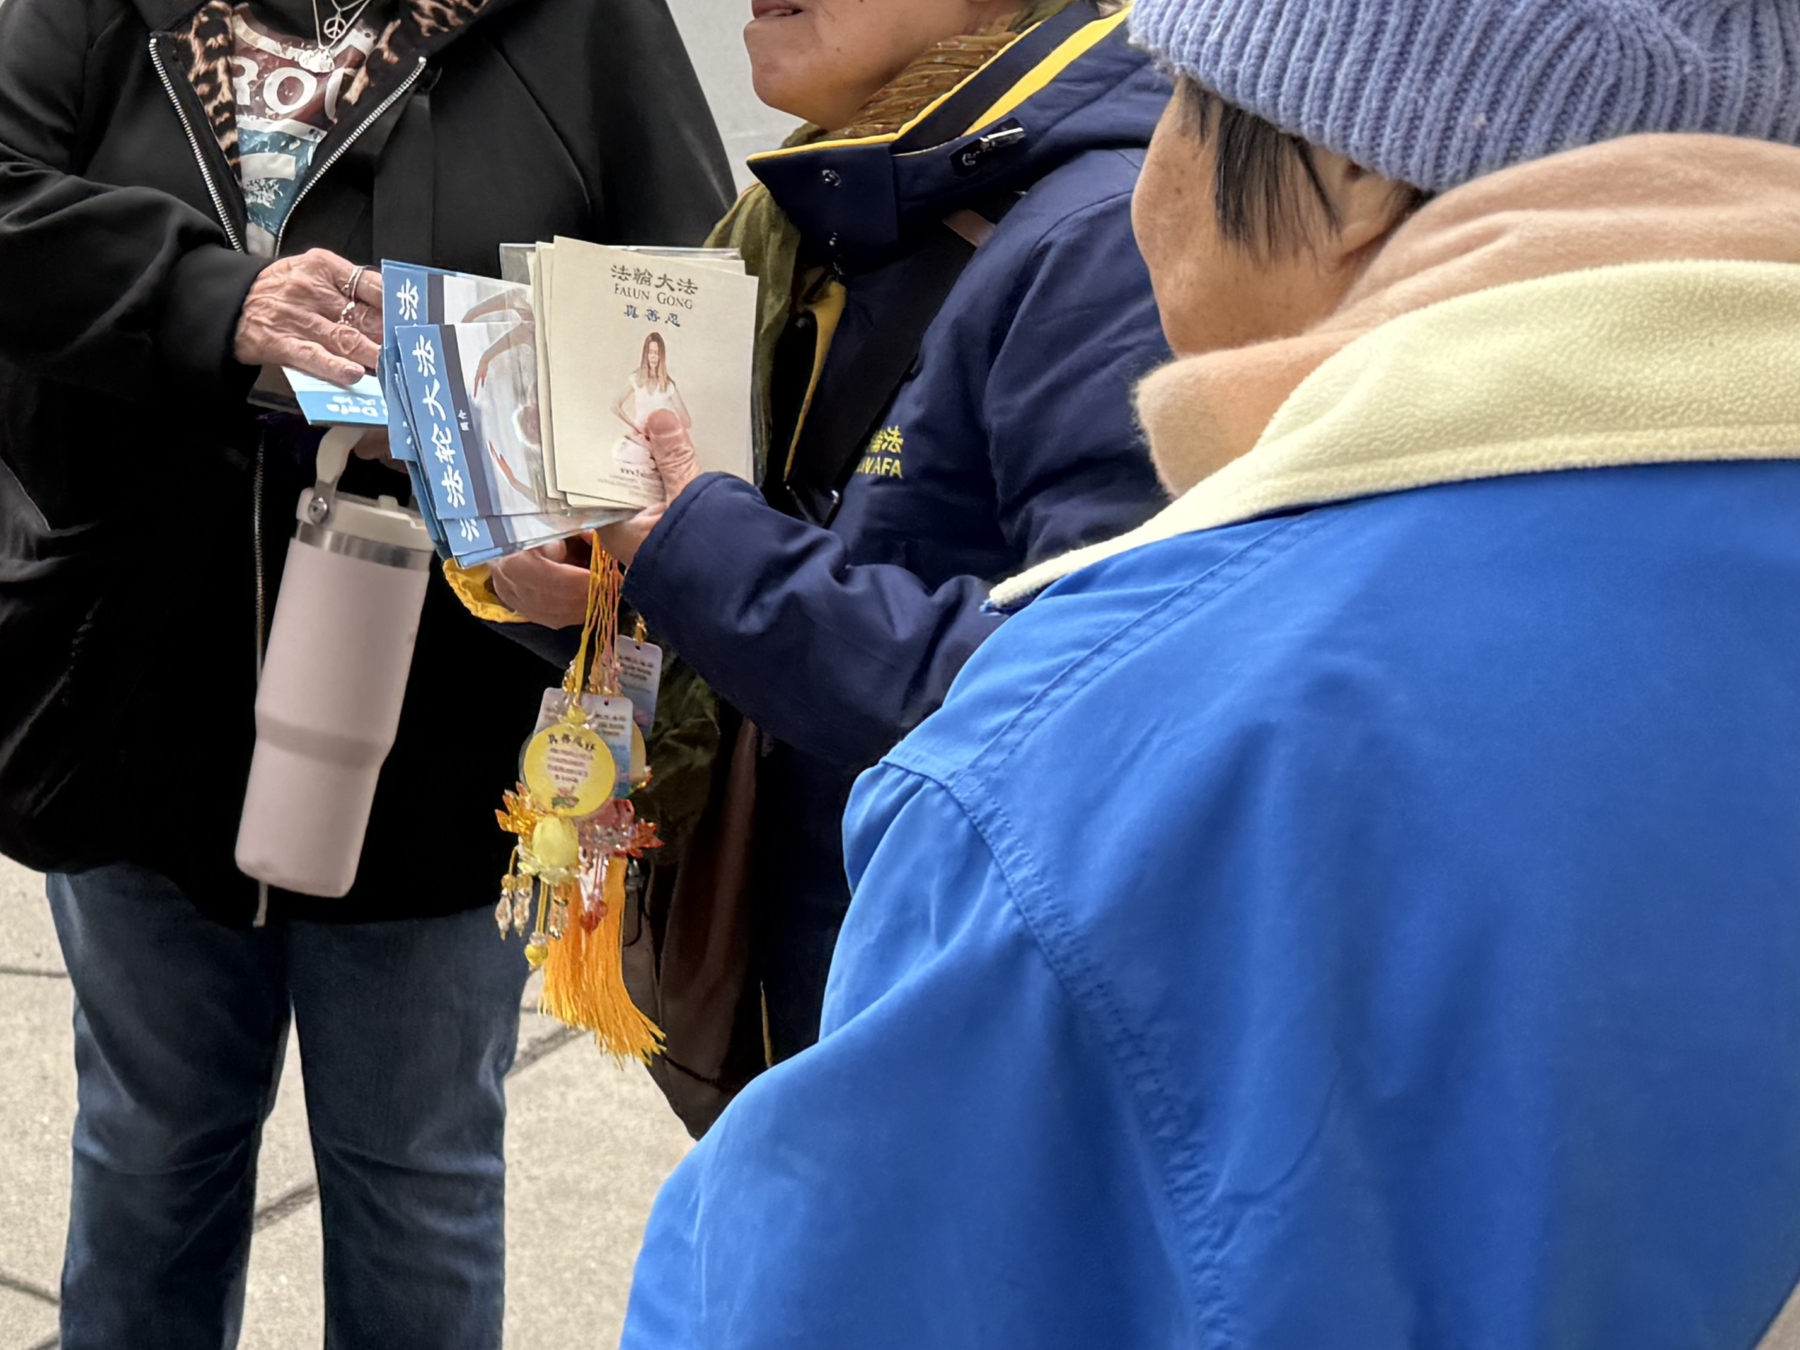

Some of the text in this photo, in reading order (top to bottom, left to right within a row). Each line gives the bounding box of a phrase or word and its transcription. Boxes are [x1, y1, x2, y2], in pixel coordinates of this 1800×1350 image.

[610, 265, 699, 295] 法輪大法
[614, 283, 694, 310] FALUN GONG
[411, 334, 466, 509] 法轮大法
